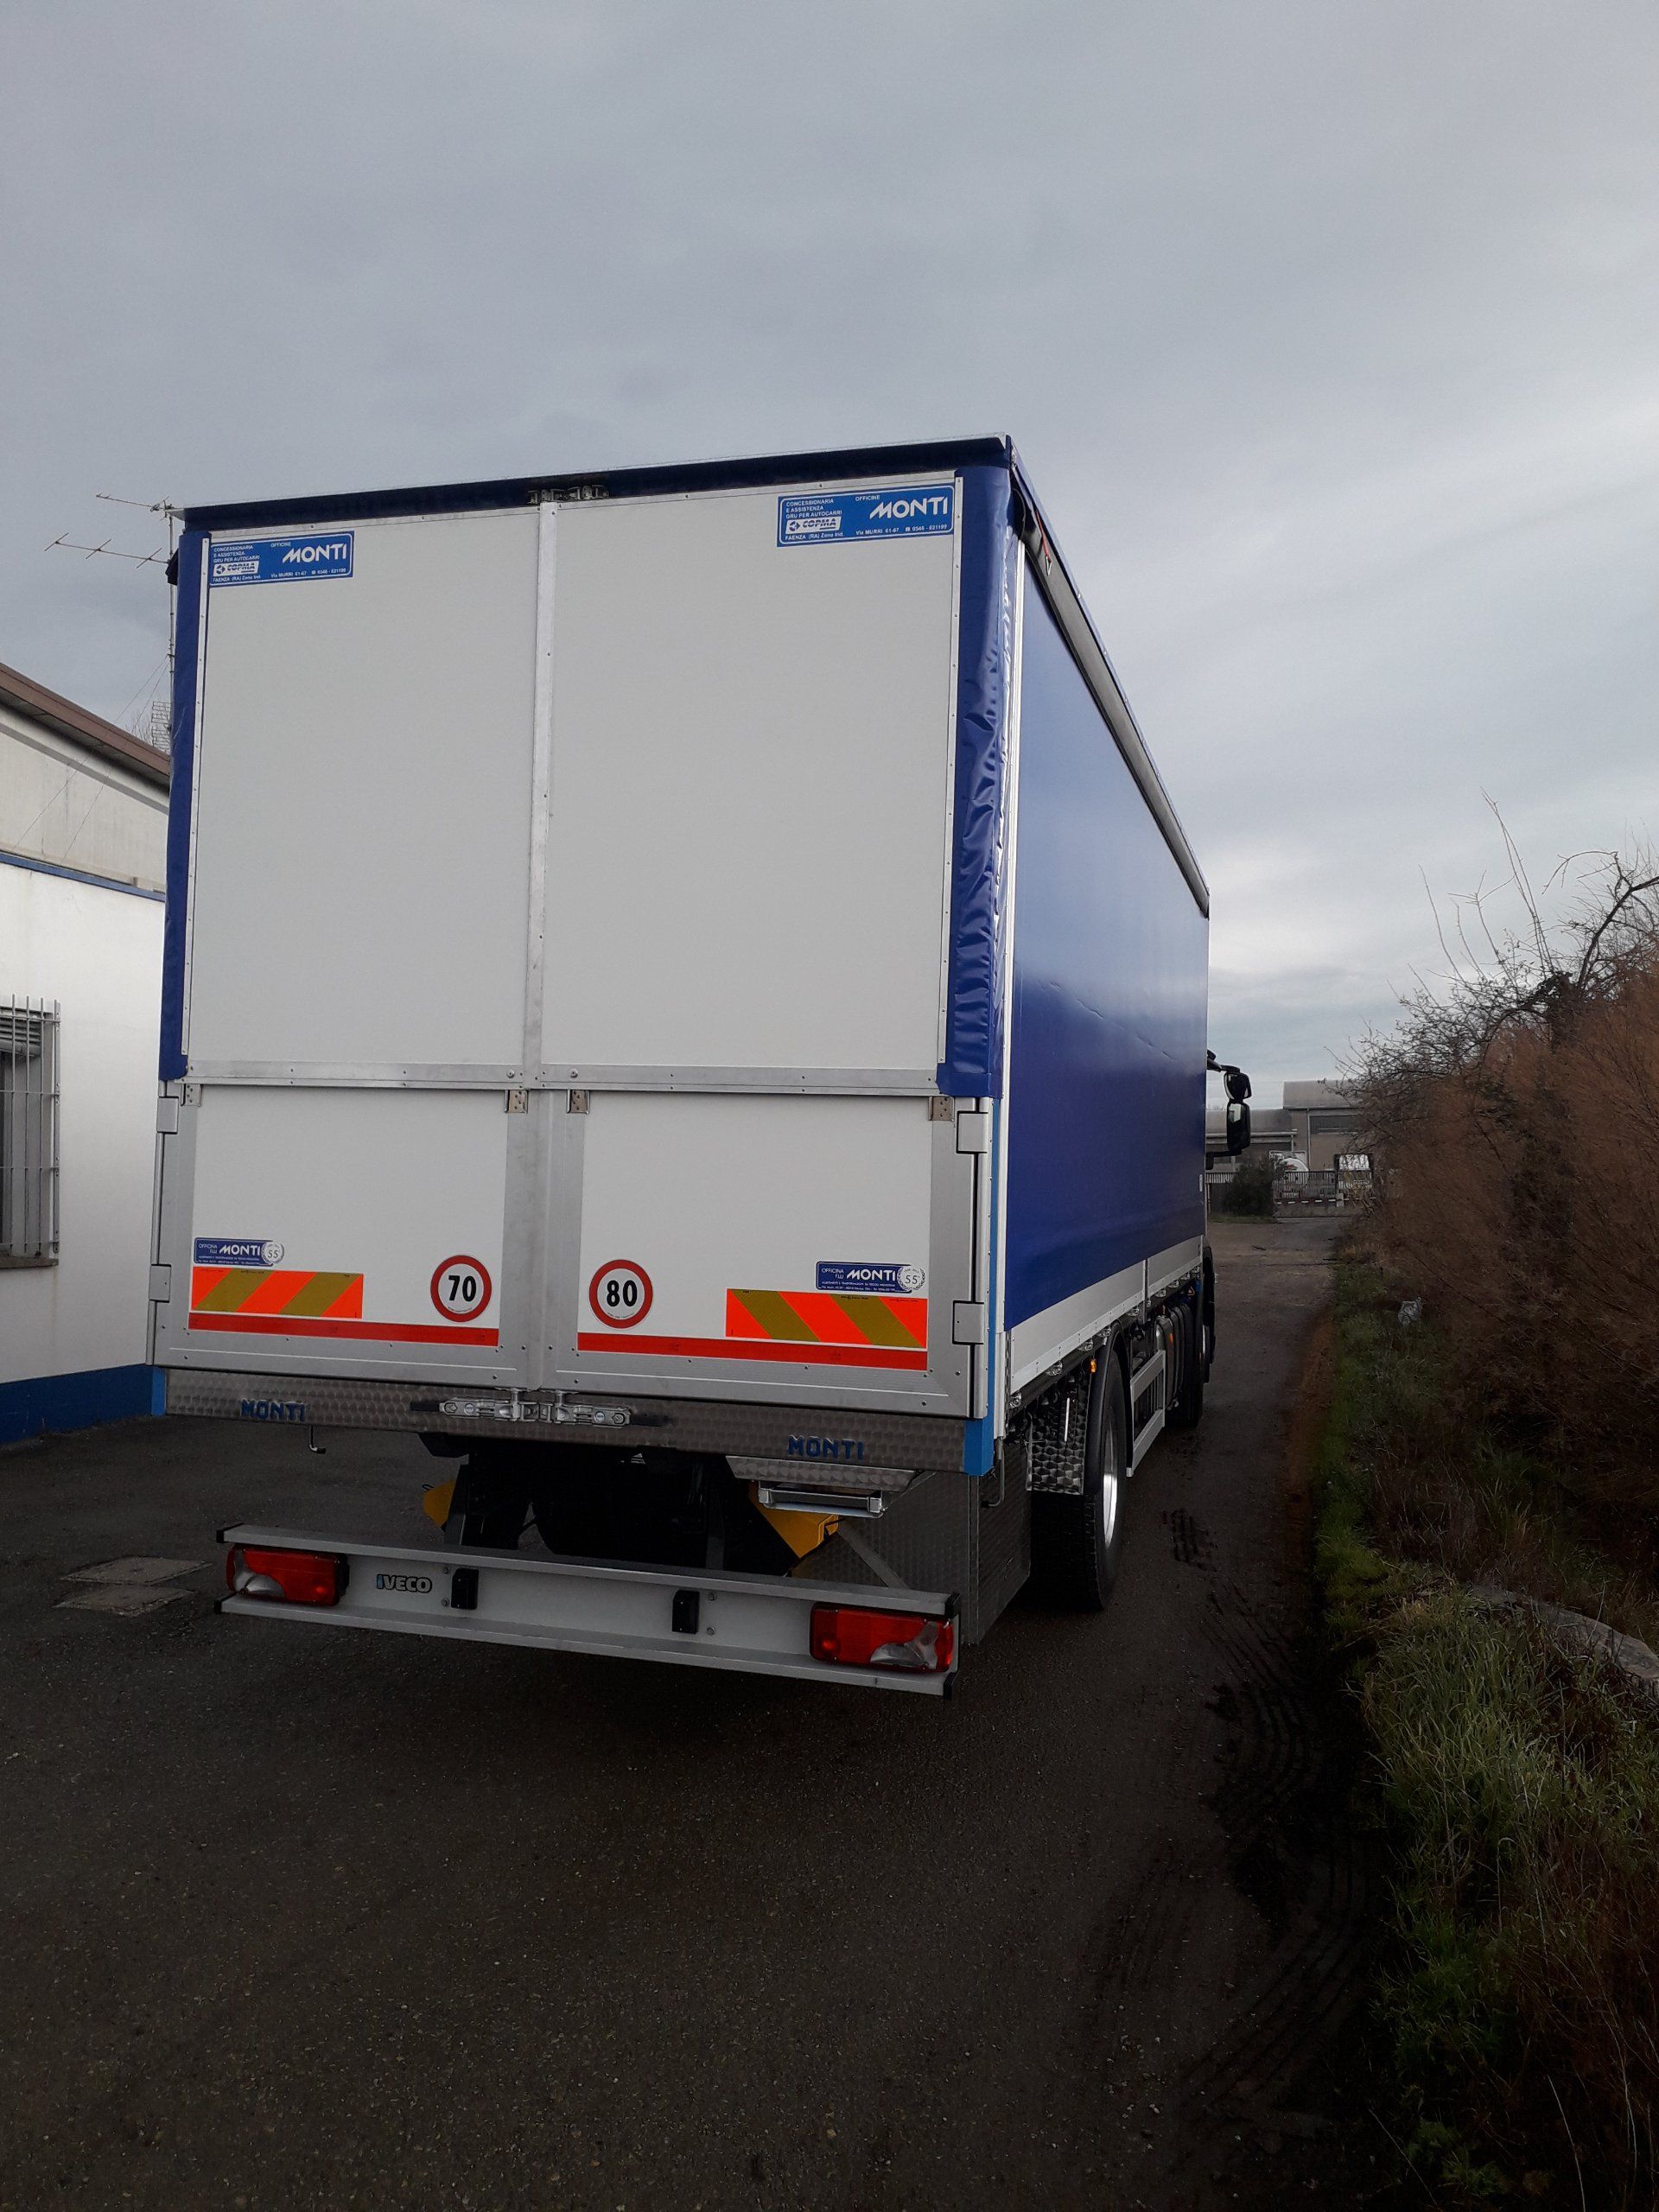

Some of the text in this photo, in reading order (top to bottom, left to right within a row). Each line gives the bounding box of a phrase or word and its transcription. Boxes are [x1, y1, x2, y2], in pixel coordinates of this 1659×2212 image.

[786, 499, 834, 507] CONCESSIONARIA
[869, 497, 948, 519] MONTI
[282, 543, 347, 563] MONTI
[219, 1244, 260, 1256] MONTI
[846, 1268, 896, 1281] MONTI
[448, 1274, 477, 1302] 70
[607, 1280, 638, 1307] 80
[241, 1398, 306, 1422] MONTI
[788, 1434, 865, 1460] MONTI
[376, 1573, 433, 1593] IVECO
